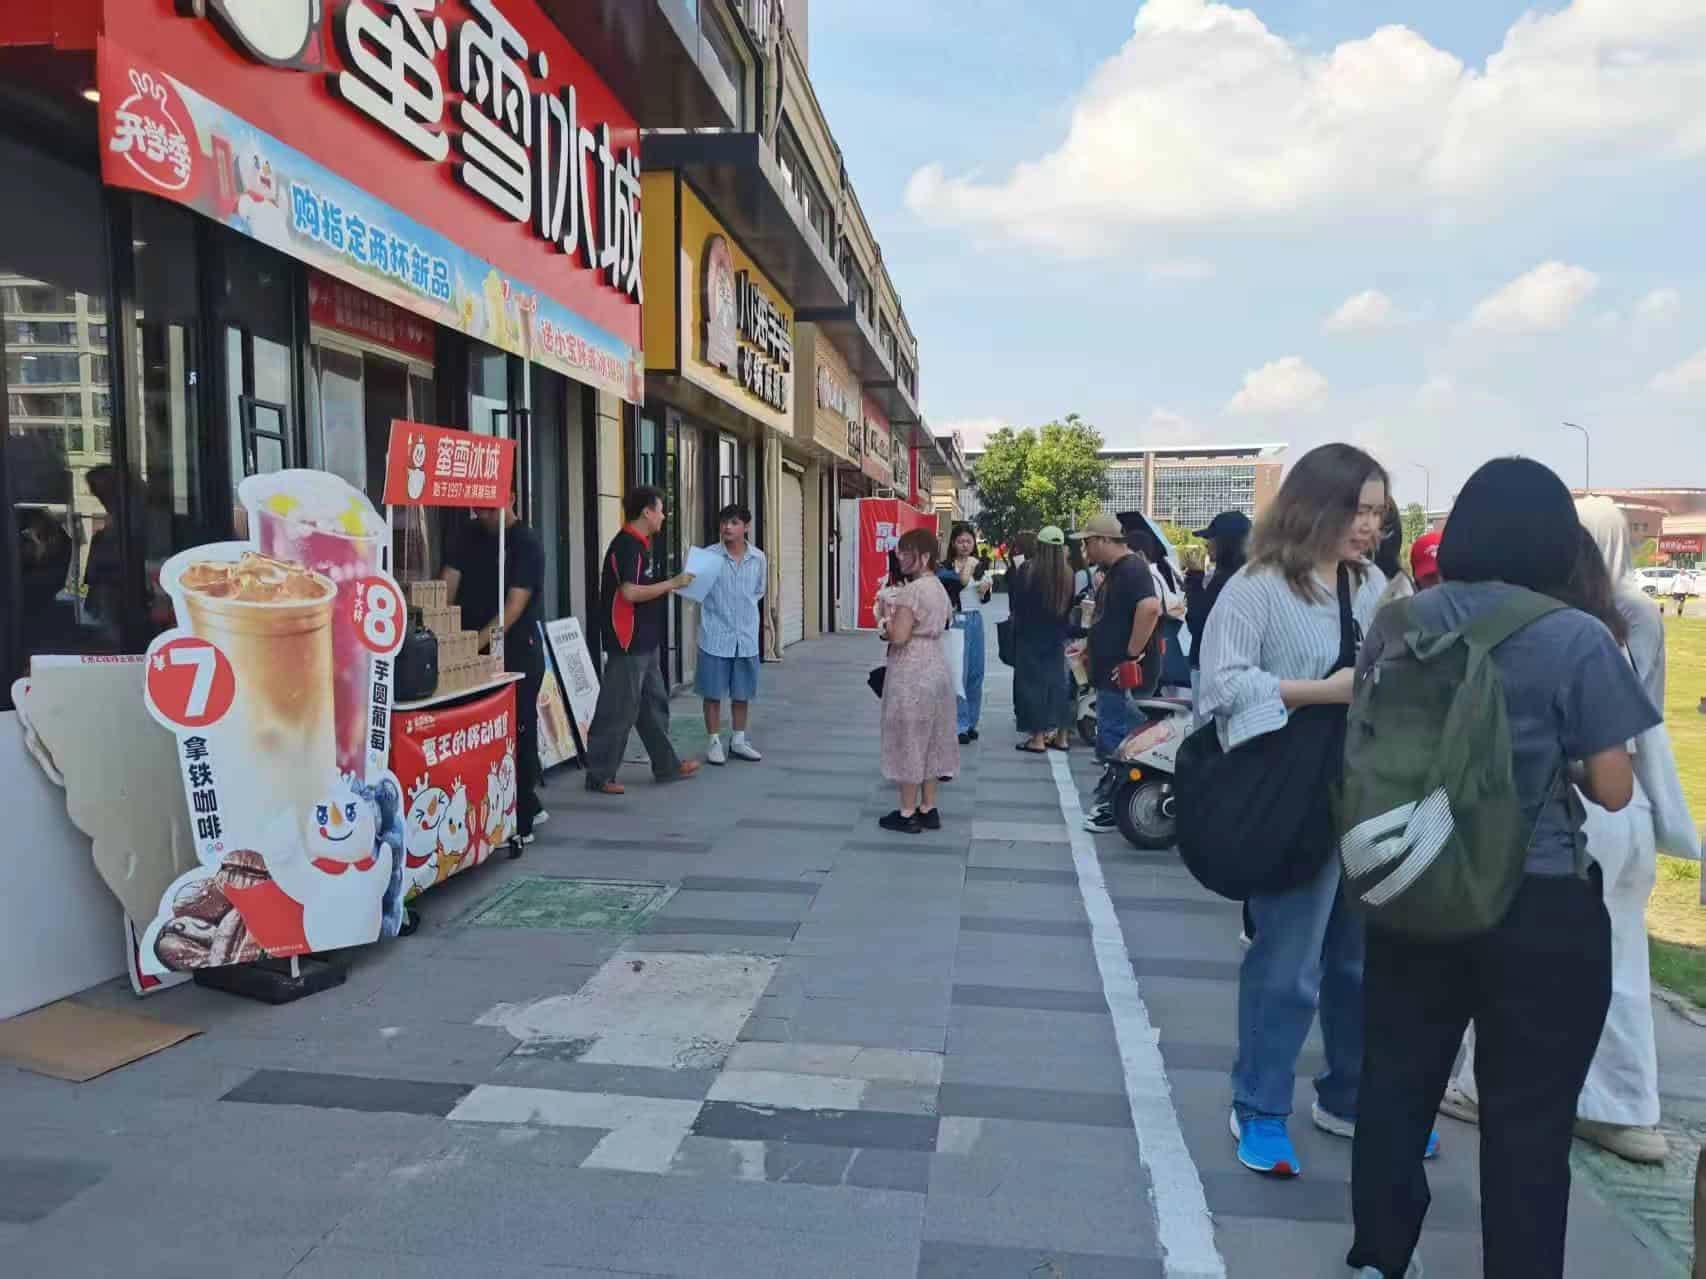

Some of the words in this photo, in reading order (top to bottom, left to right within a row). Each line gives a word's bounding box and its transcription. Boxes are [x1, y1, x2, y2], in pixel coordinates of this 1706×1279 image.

[110, 110, 191, 178] 开学季
[338, 0, 642, 305] 蜜雪冰城
[291, 182, 451, 301] 购指定两杯新品
[434, 435, 500, 480] 蜜雪冰城
[371, 659, 390, 752] 芋圆葡萄
[184, 735, 222, 840] 拿铁咖啡
